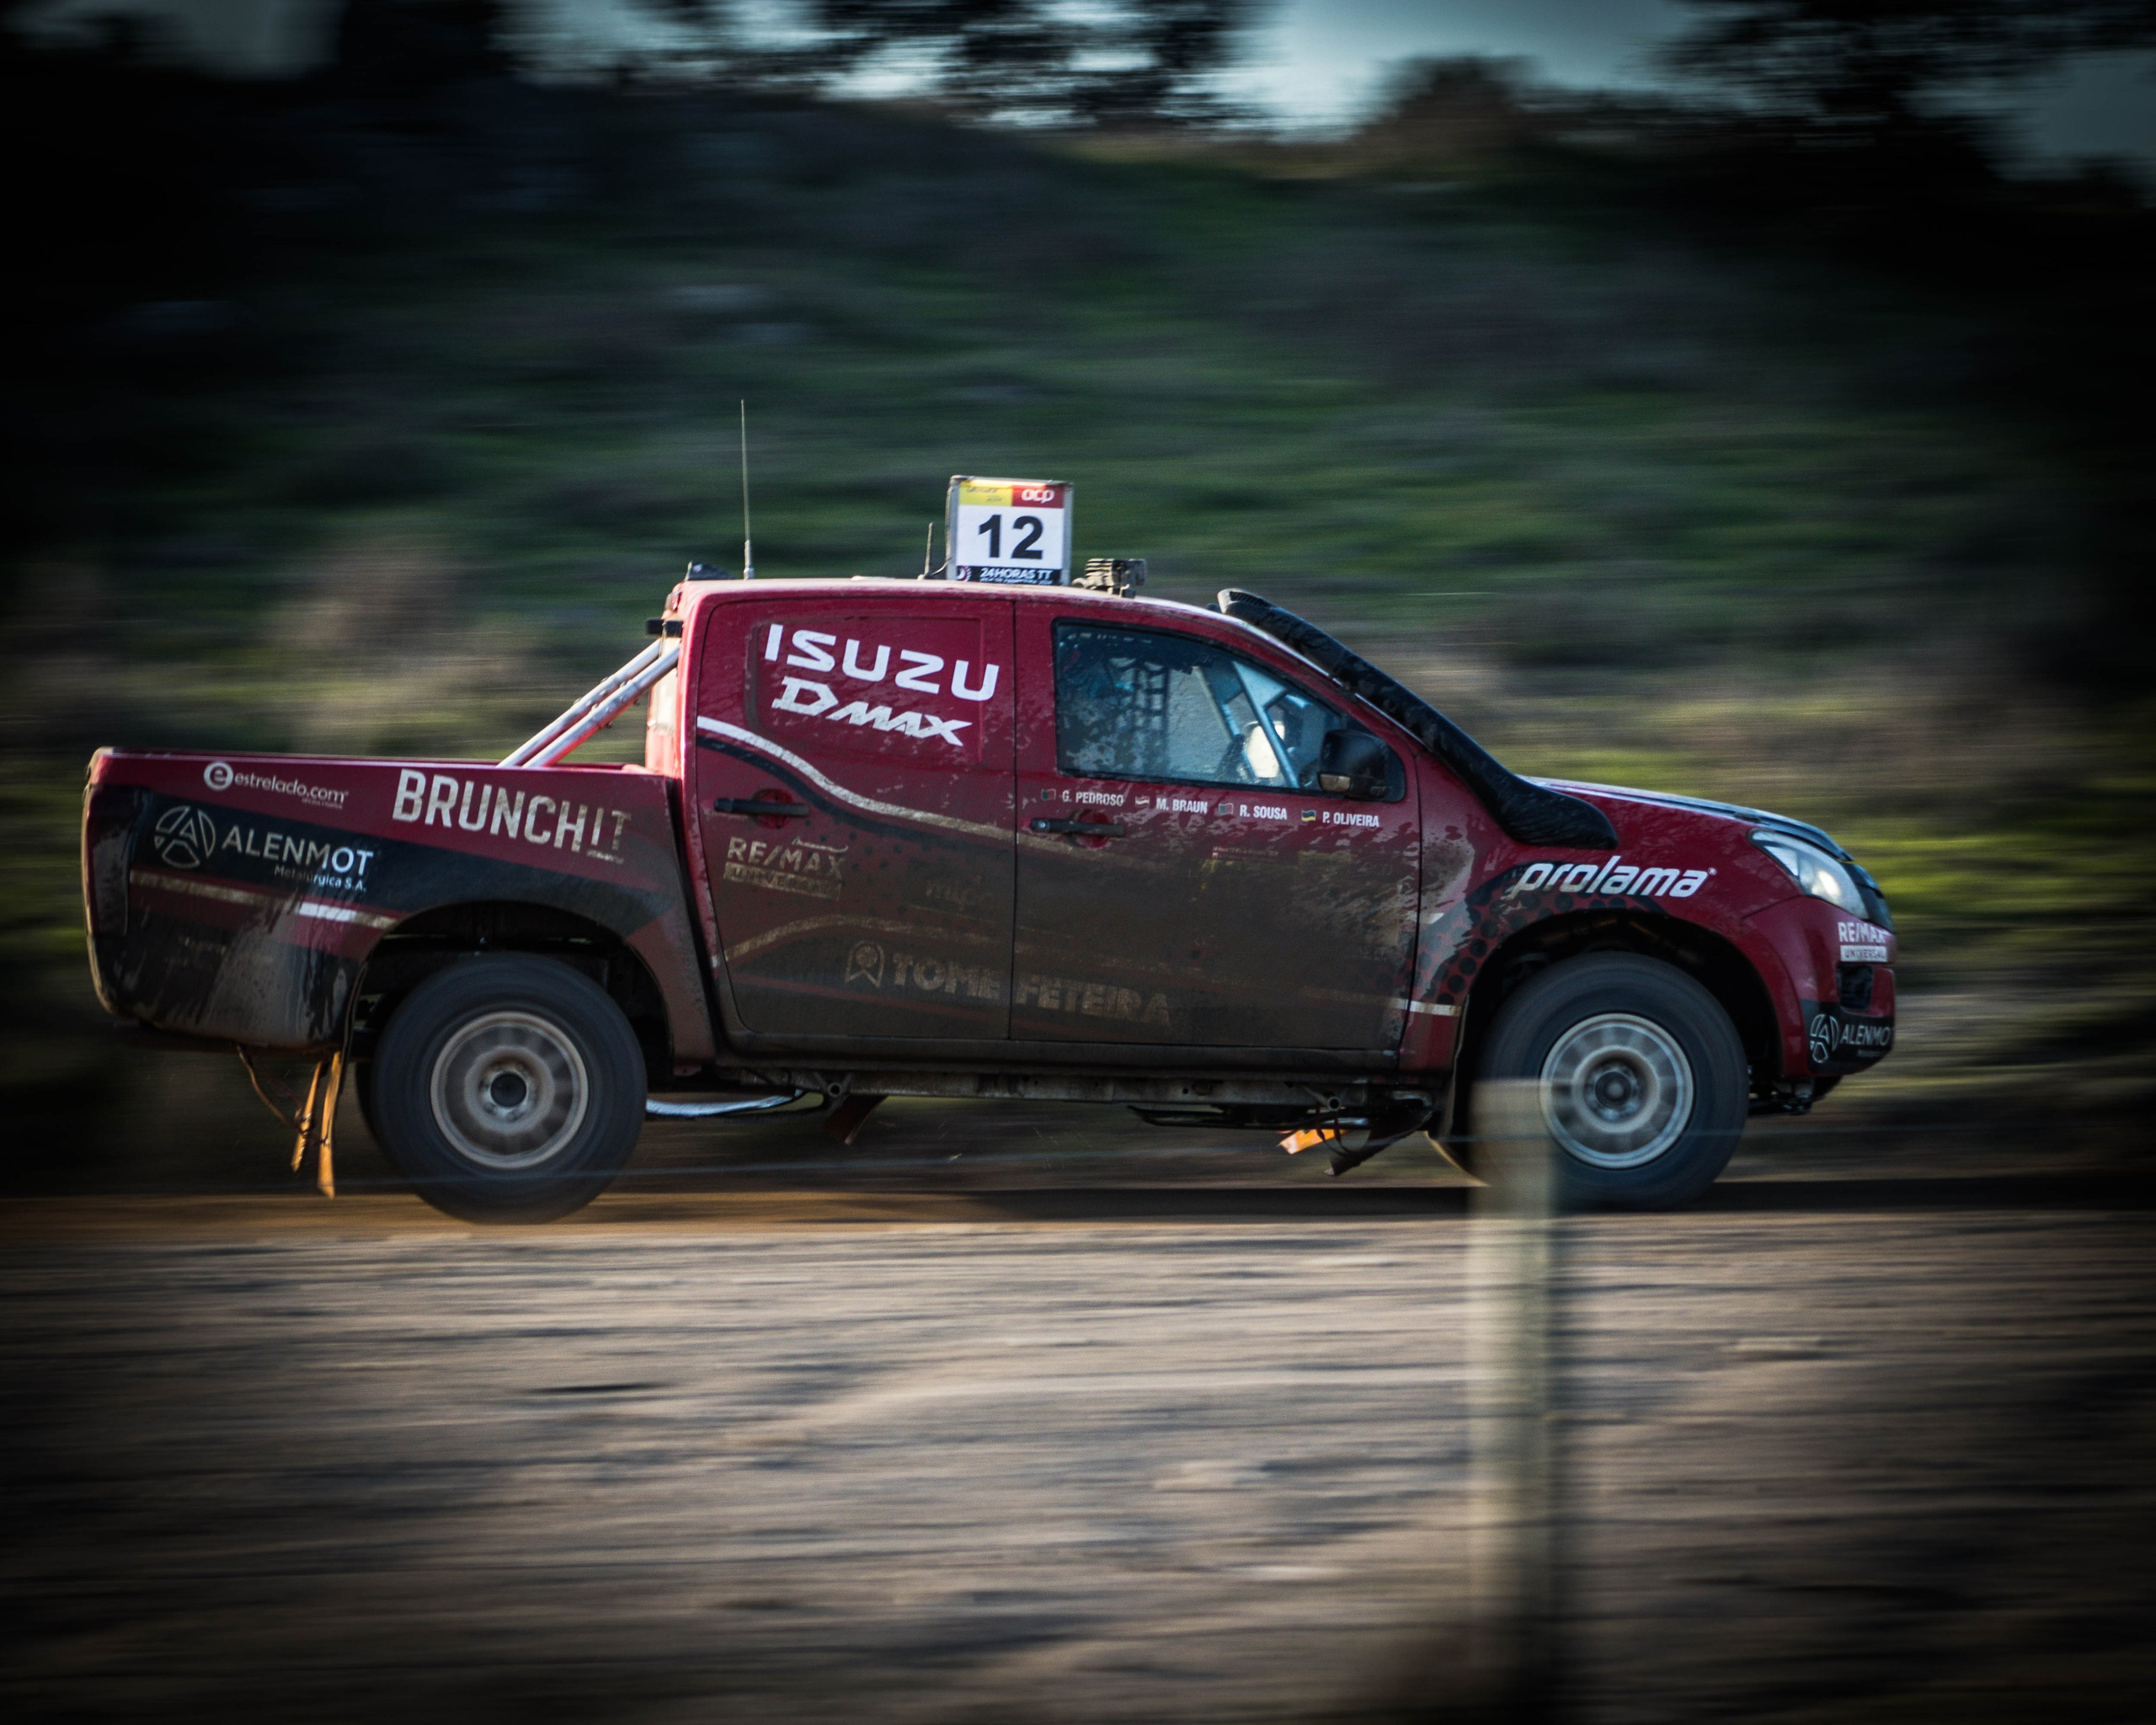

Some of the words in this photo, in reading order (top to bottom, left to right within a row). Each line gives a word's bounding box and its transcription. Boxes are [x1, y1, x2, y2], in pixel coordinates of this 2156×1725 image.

[979, 514, 1043, 560] 12
[1038, 569, 1054, 581] TT
[765, 623, 1000, 702] ISUZU
[392, 768, 631, 852] BRUNCHIT
[1062, 790, 1072, 803] G.
[1075, 792, 1124, 807] PEDROSO
[1155, 798, 1169, 811] M.
[1172, 798, 1208, 814] BRAUN
[1240, 804, 1250, 818] R.
[1253, 805, 1287, 820] SOUSA
[1322, 811, 1331, 824] P.
[1333, 812, 1380, 827] OLIVEIRA
[221, 825, 374, 876] ALENMOT
[727, 836, 846, 880] RE/MAX
[1838, 921, 1886, 943] RE/MAX
[1839, 1023, 1892, 1047] ALENMO
